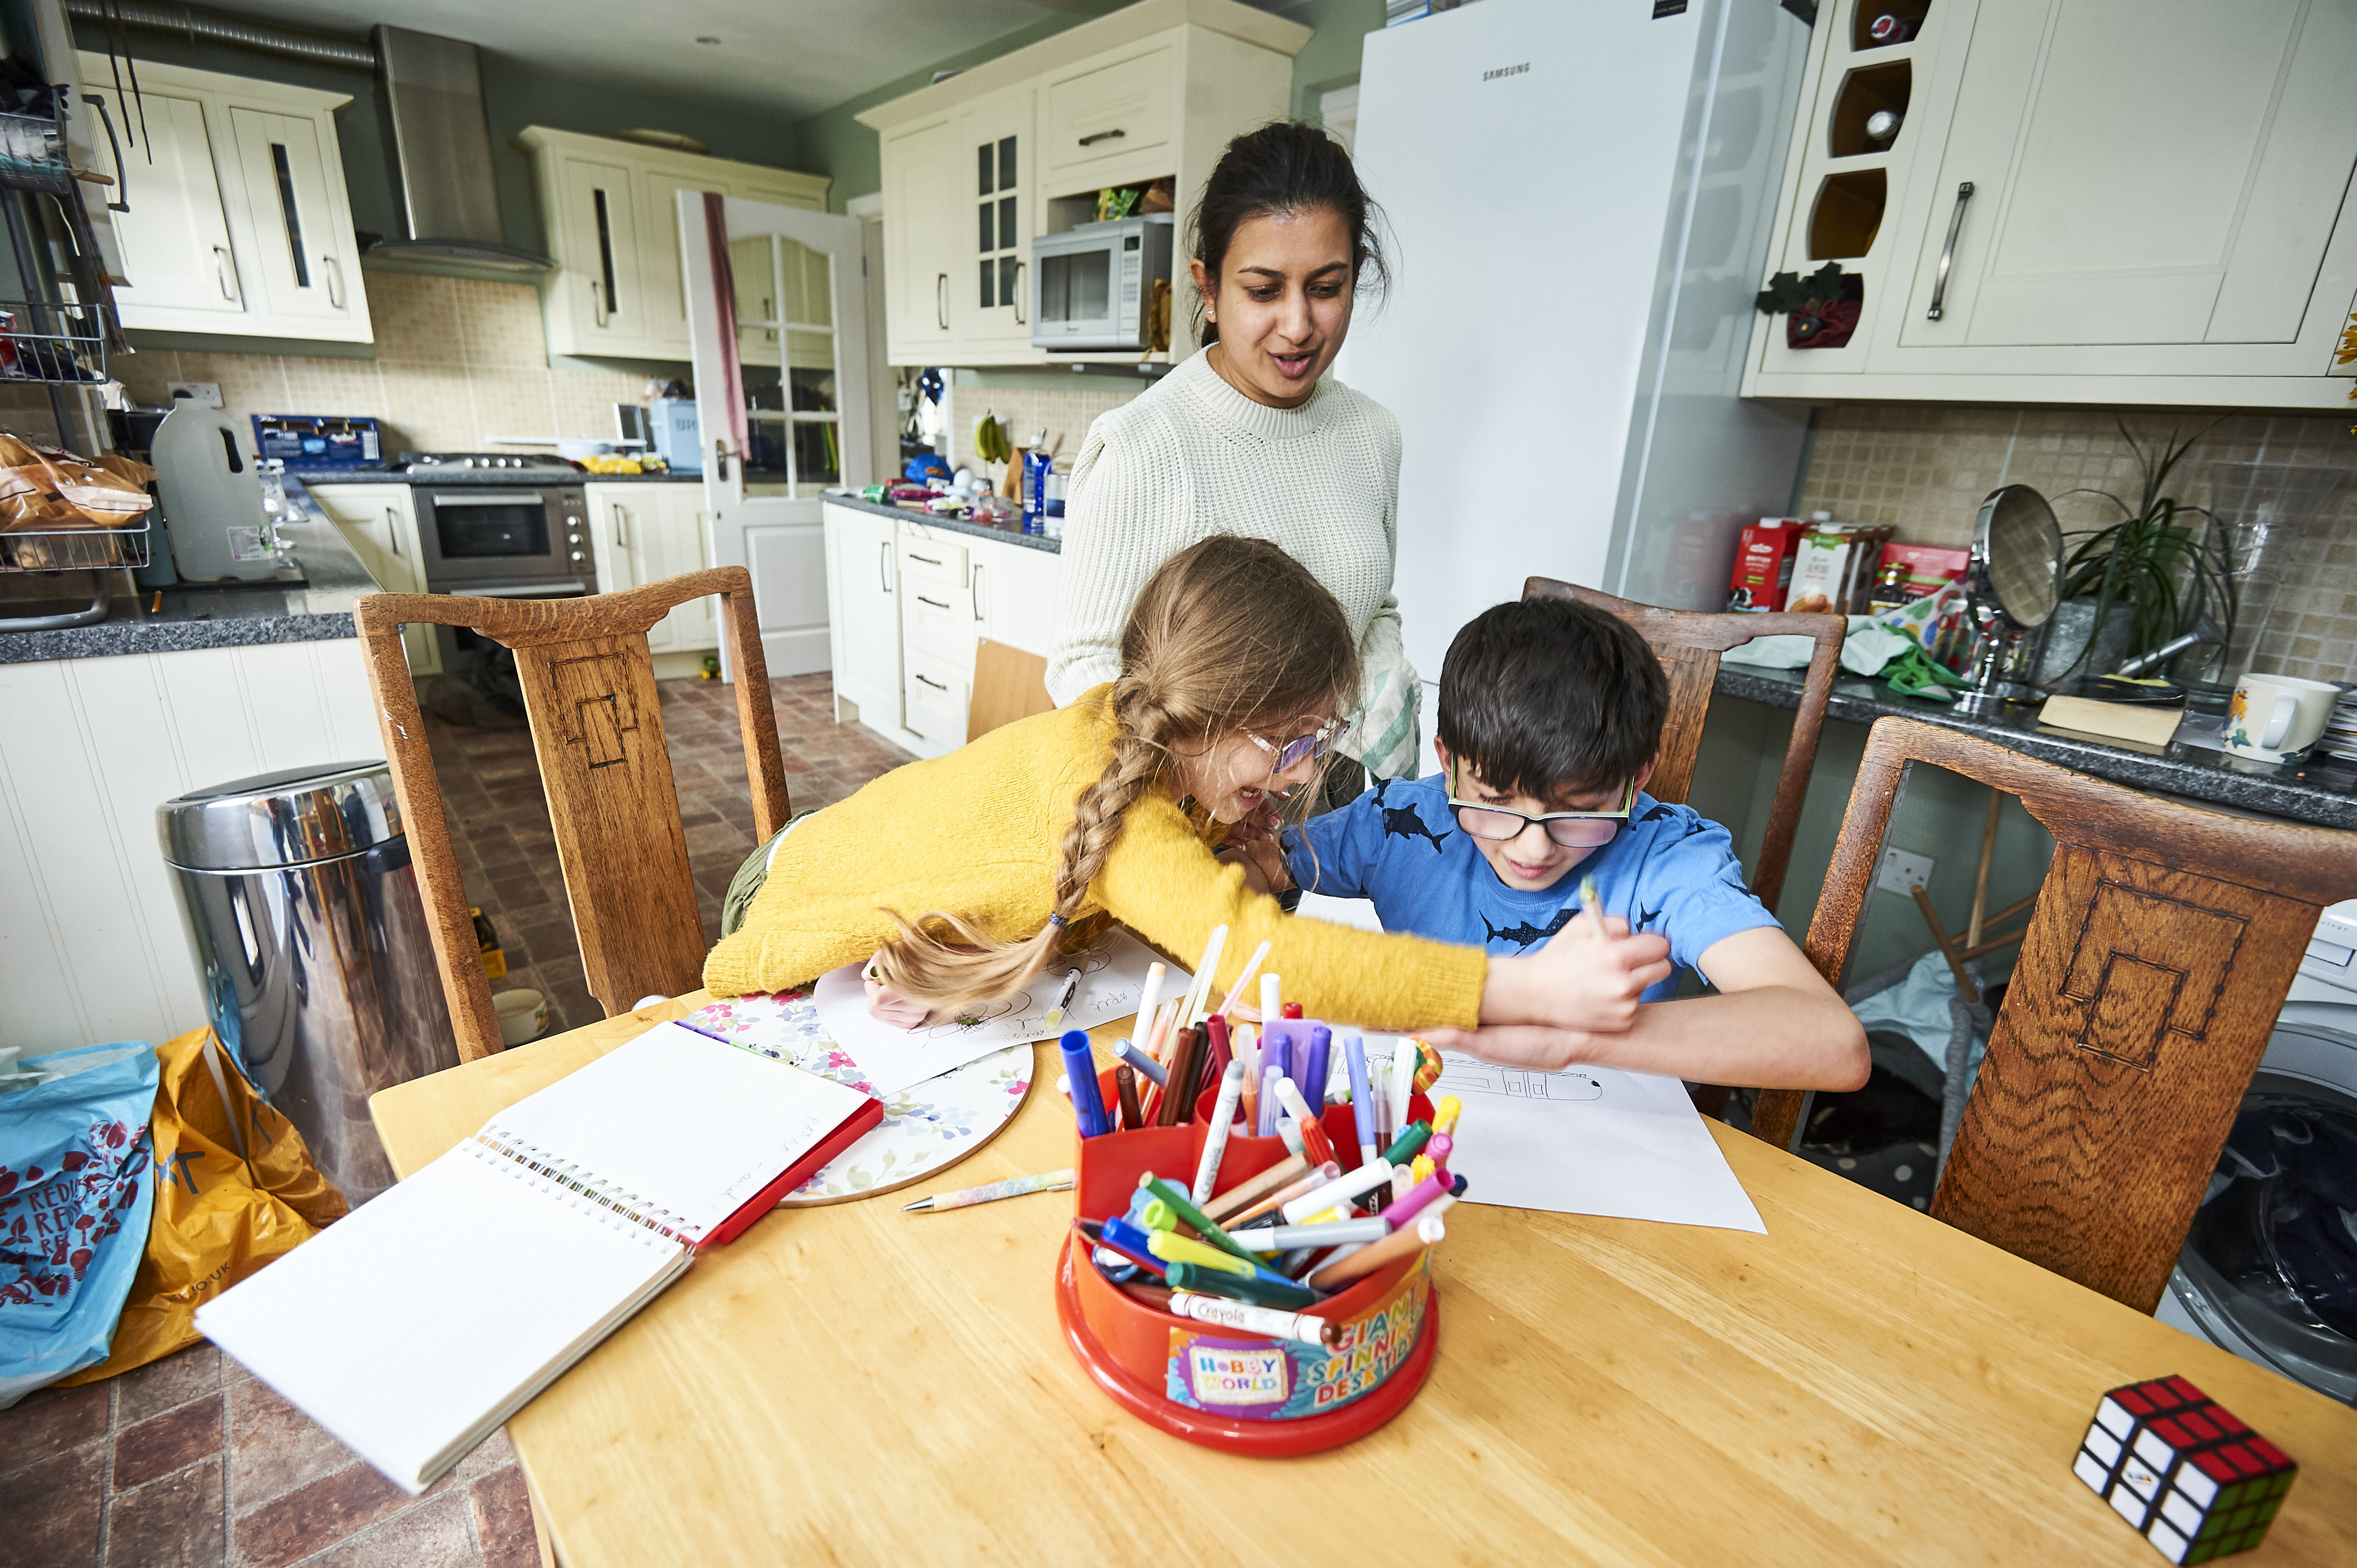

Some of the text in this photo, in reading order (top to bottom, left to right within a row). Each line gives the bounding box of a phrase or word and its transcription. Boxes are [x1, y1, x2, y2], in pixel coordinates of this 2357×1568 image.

[1483, 62, 1530, 81] SAMSUNG
[1198, 1303, 1245, 1325] Crayola
[1200, 1356, 1275, 1375] HOBBY
[1203, 1375, 1276, 1390] WORLD
[1315, 1364, 1377, 1407] DESK
